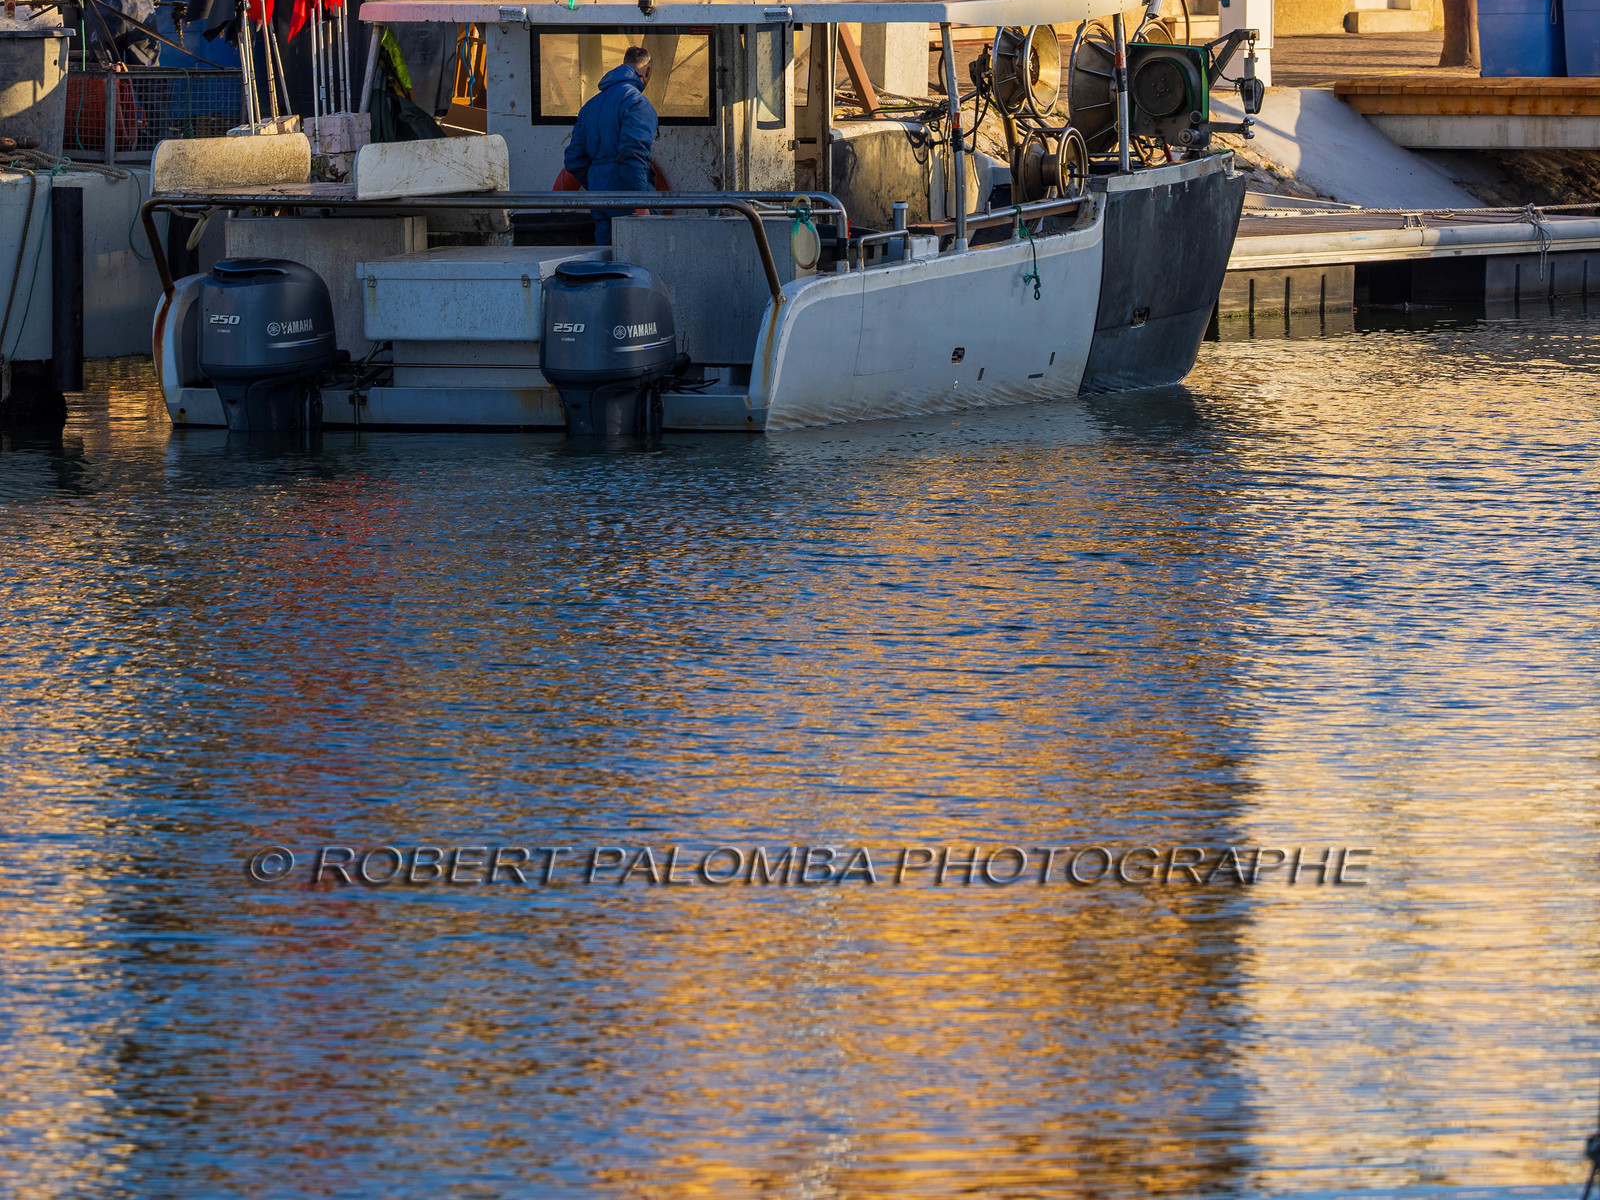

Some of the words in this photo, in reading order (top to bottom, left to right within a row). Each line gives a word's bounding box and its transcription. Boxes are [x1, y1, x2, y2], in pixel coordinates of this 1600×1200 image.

[209, 314, 240, 325] 250
[280, 318, 313, 335] YAMAHA
[553, 322, 585, 333] 250
[626, 322, 658, 338] YAMAHA
